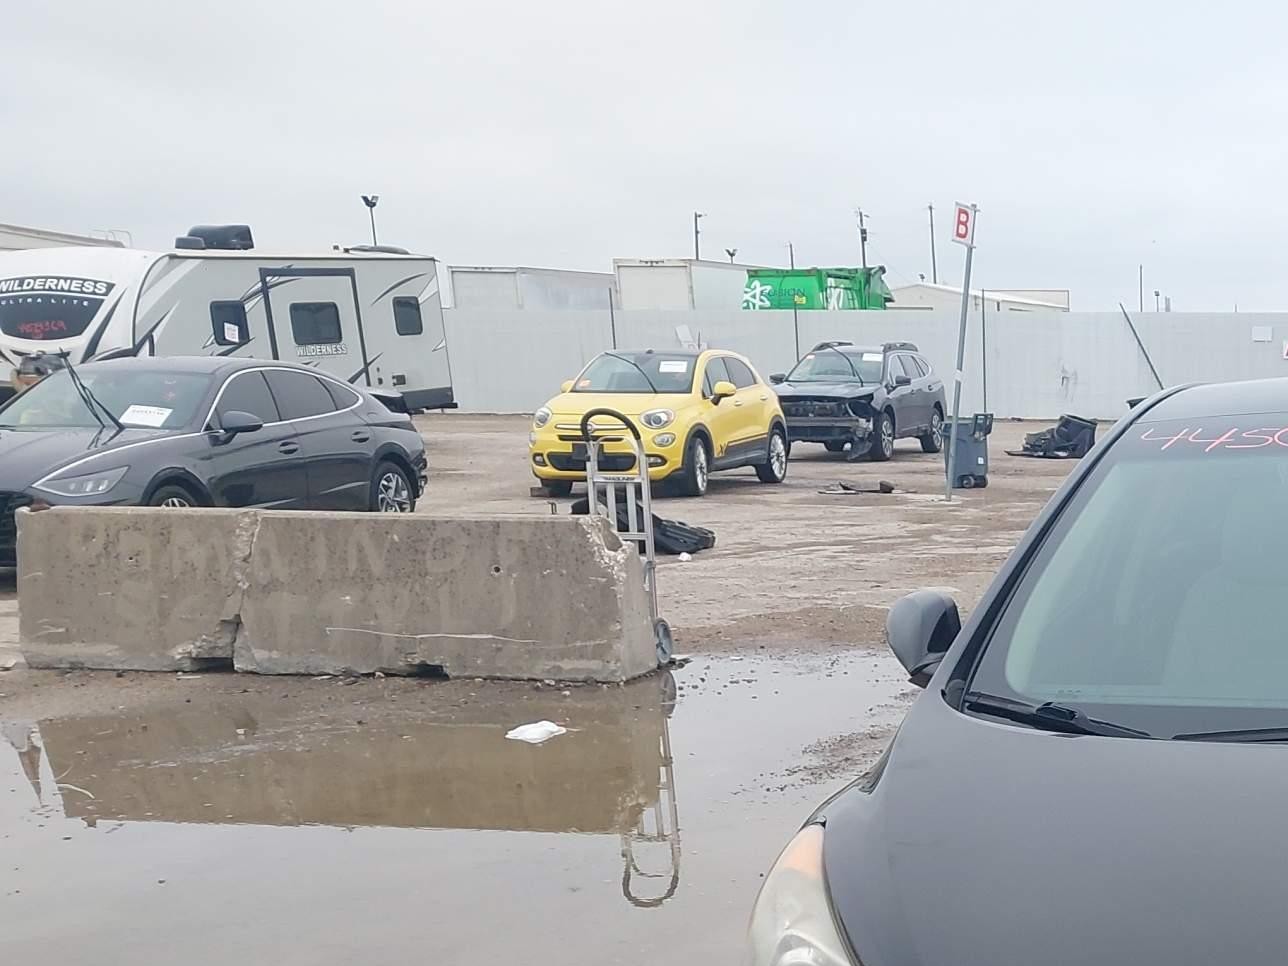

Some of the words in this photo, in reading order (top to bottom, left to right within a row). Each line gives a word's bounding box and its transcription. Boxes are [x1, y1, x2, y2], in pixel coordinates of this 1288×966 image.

[956, 207, 970, 239] B
[0, 278, 108, 294] WILDERNESS
[0, 297, 42, 305] ULTRA
[51, 298, 88, 307] LITE
[296, 344, 347, 357] WILDERNESS
